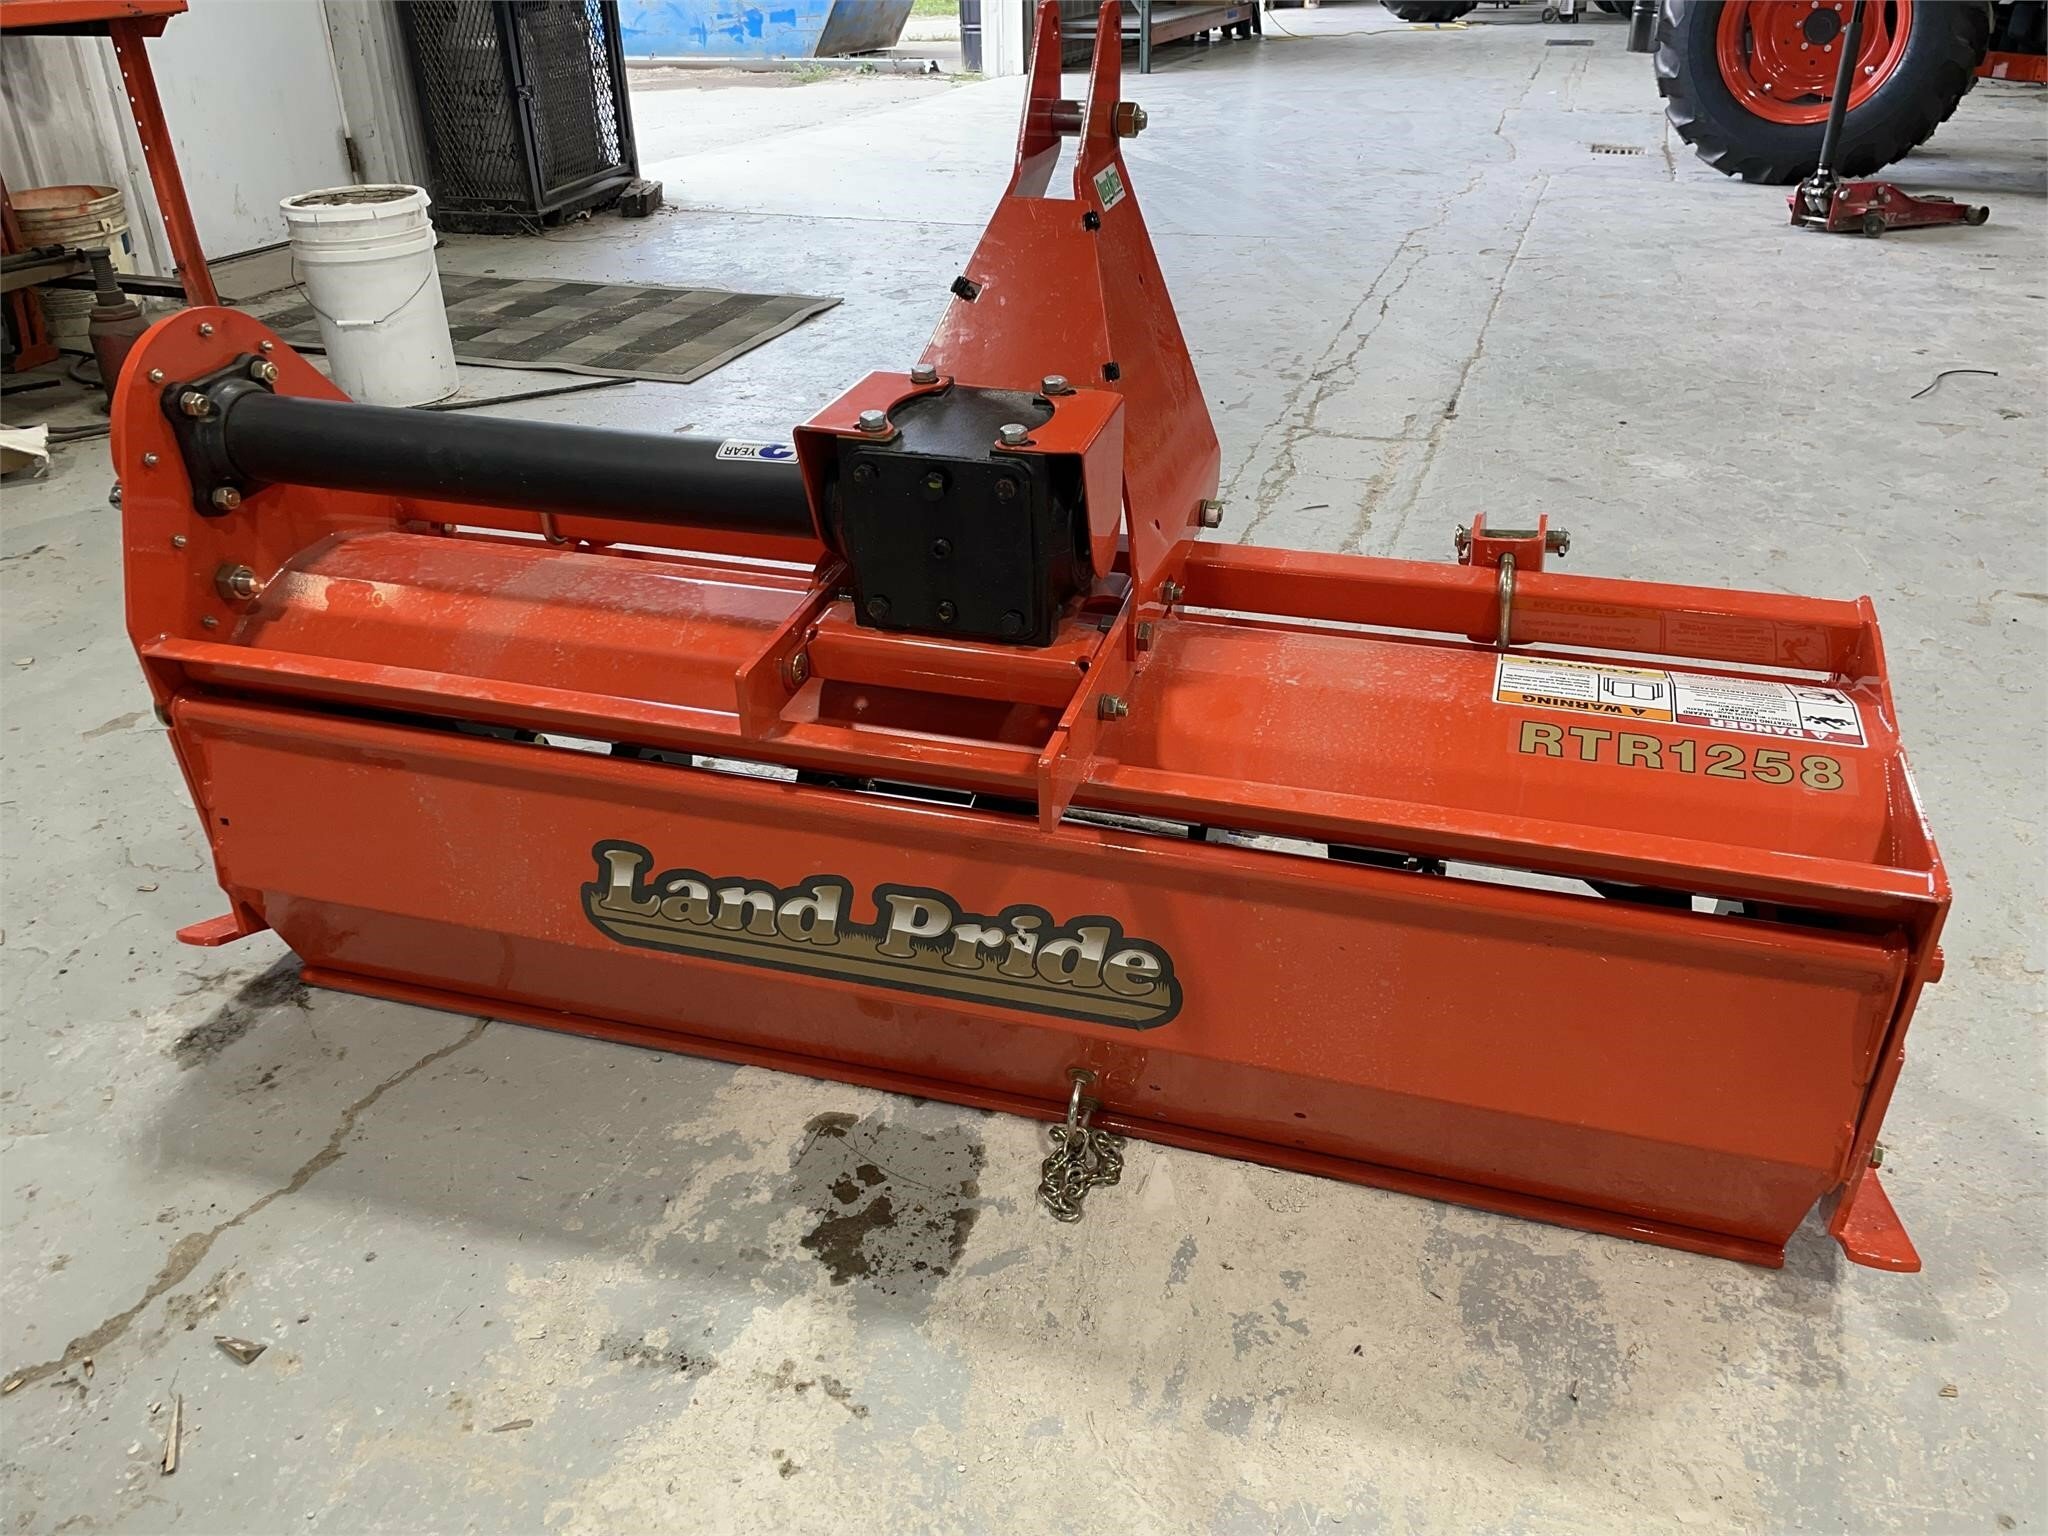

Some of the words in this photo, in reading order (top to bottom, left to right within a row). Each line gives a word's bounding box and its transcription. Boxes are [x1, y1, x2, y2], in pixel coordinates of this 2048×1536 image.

[724, 446, 756, 457] YEAR
[1522, 694, 1623, 714] WARNING
[1709, 718, 1803, 737] DANGER
[1519, 720, 1844, 790] RTR1258
[600, 849, 841, 946] Land
[878, 894, 1162, 996] Pride
